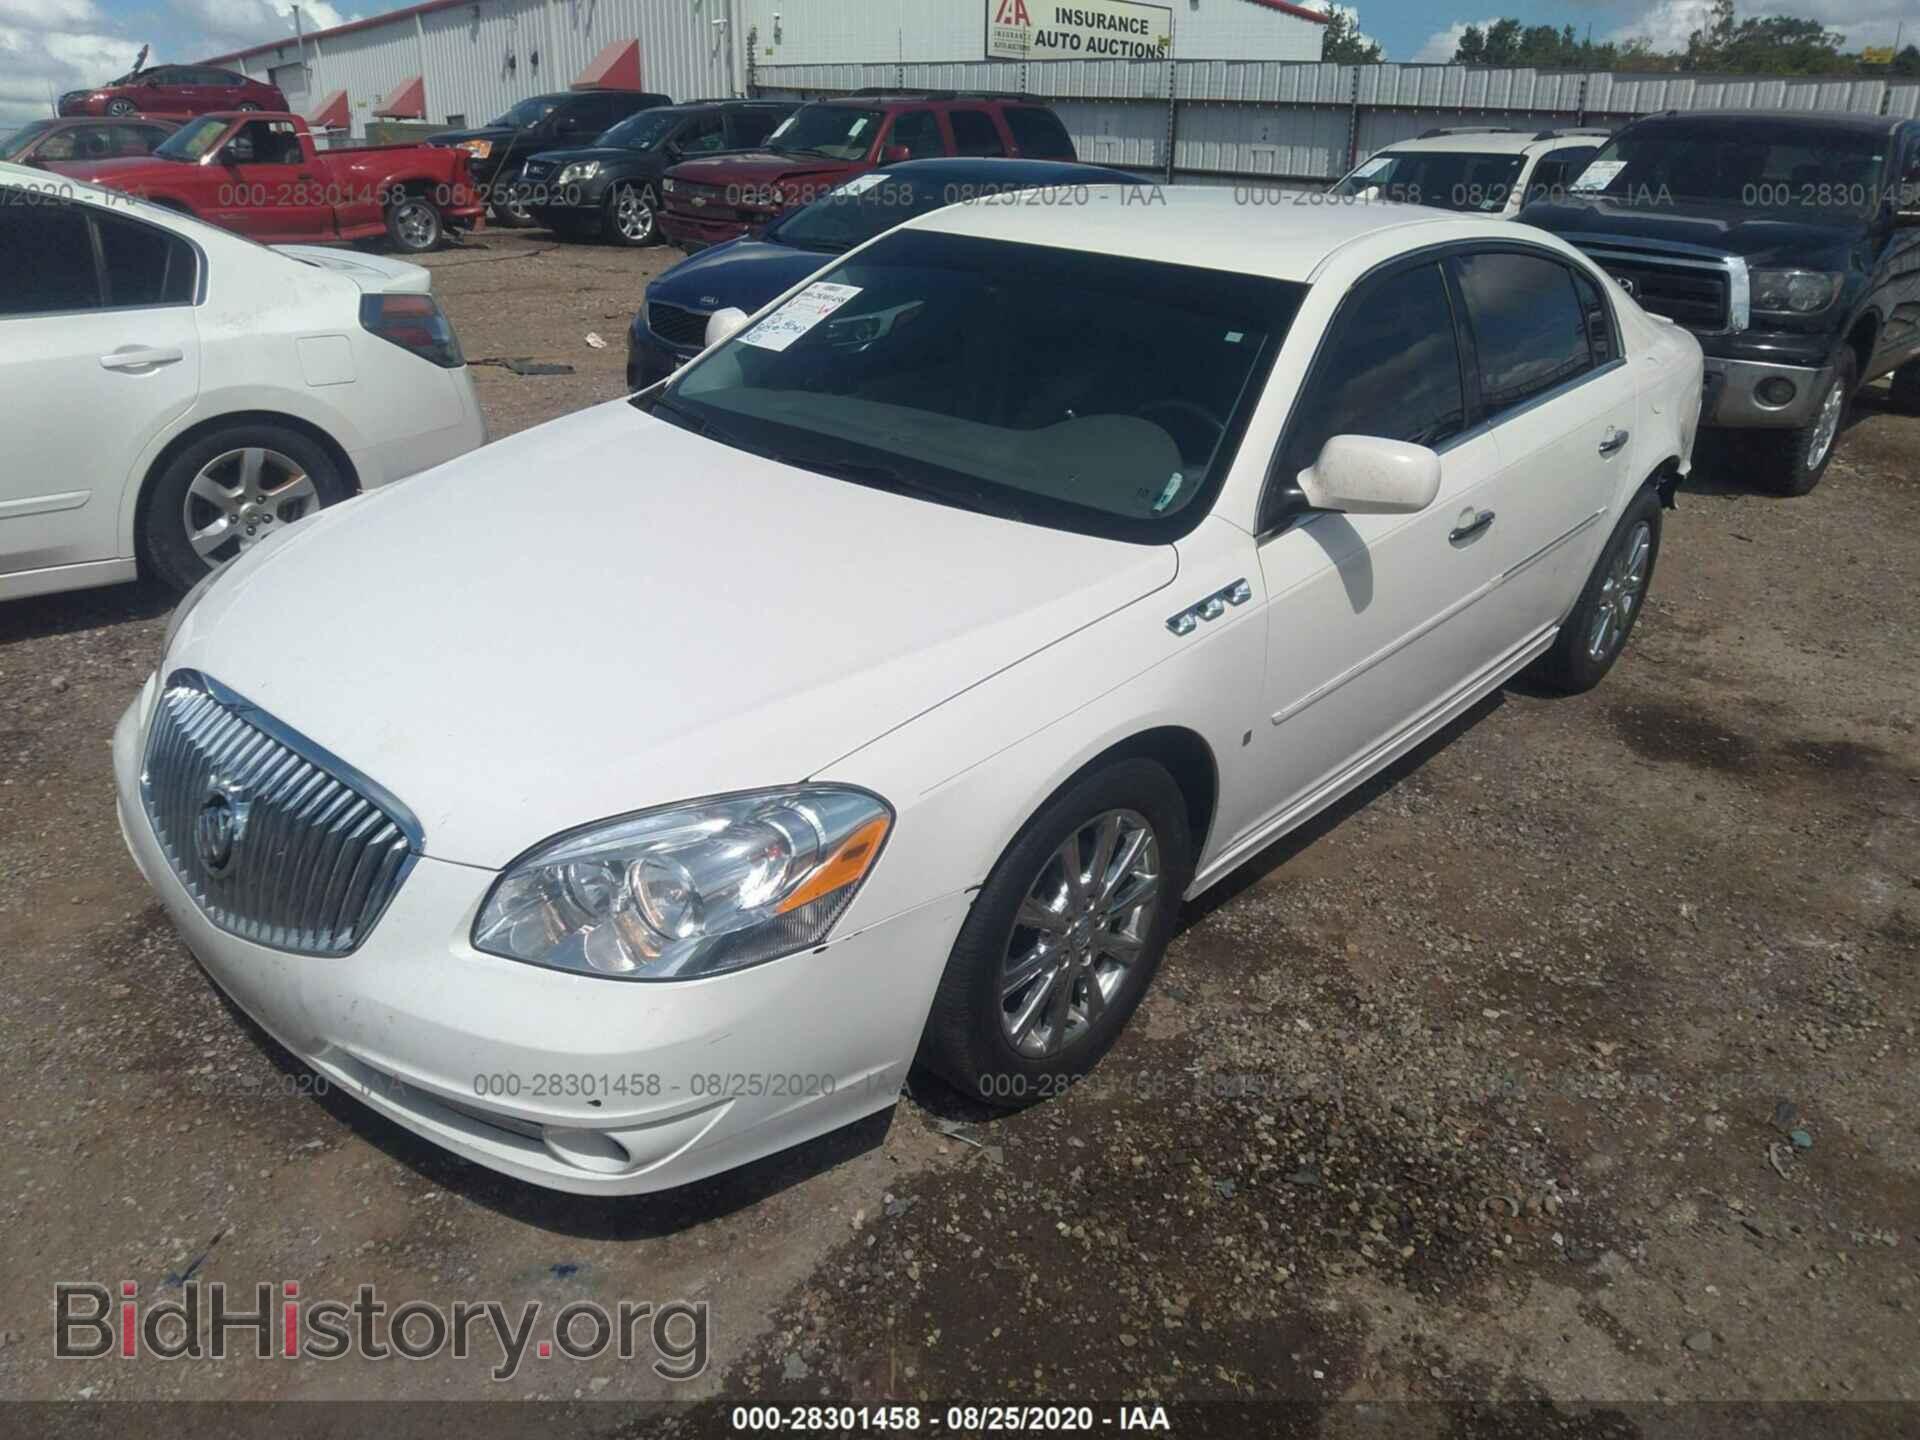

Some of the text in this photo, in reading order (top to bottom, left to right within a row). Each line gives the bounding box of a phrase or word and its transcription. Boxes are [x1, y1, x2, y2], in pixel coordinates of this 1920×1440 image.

[1055, 7, 1149, 35] INSURANCE
[1034, 29, 1165, 59] AUTO AUCTIONS
